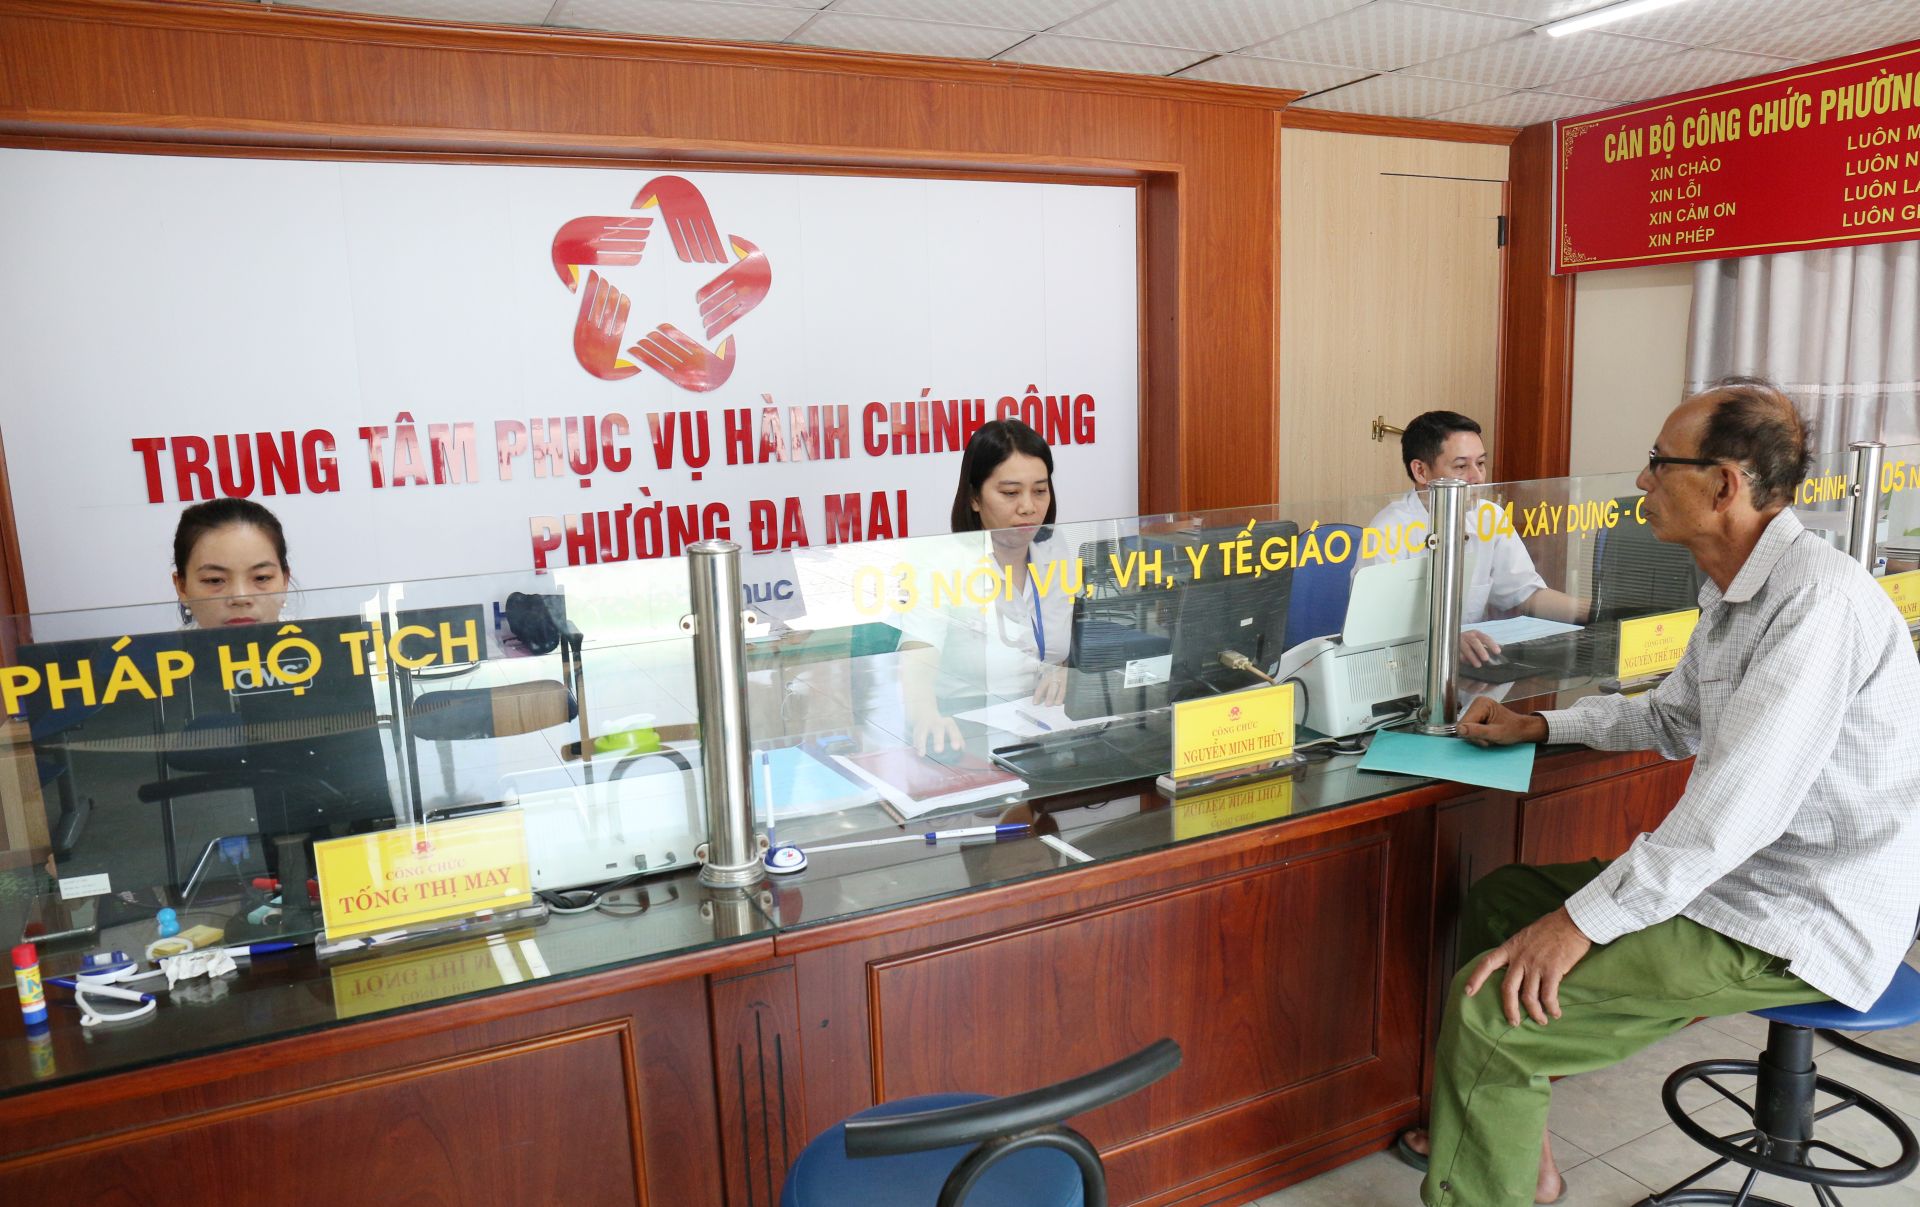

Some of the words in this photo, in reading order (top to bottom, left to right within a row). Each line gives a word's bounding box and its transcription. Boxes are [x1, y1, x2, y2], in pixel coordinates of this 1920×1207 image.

[1604, 125, 1643, 163] CÁN
[1649, 115, 1676, 160] BỘ
[1682, 108, 1741, 149] CÔNG
[1748, 87, 1812, 137] CHỨC
[1847, 126, 1900, 151] LUÔN
[1650, 166, 1674, 181] XIN
[1677, 155, 1721, 178] CHÀO
[1845, 153, 1899, 176] LUÔN
[1650, 188, 1673, 204] XIN
[1677, 178, 1701, 201] LỖI
[1844, 179, 1897, 202] LUÔN
[1649, 210, 1672, 226] XIN
[1676, 202, 1709, 223] CẢM
[1713, 202, 1736, 218] ƠN
[1842, 205, 1895, 227] LUÔN
[1648, 233, 1672, 248] XIN
[1676, 226, 1715, 245] PHÉP
[131, 428, 341, 504] TRUNG
[358, 411, 479, 488] TÂM
[494, 412, 632, 488] PHỤC
[646, 410, 711, 481] VỤ
[724, 393, 851, 466] HÀNH
[862, 388, 986, 457] CHÍNH
[1802, 468, 1847, 505] CHÍNH
[1880, 461, 1906, 493] 05
[529, 486, 731, 575] PHƯỜNG
[748, 497, 809, 555] ĐA
[824, 490, 909, 544] MAI
[1477, 501, 1514, 542] 04
[1522, 501, 1563, 538] XÂY
[1567, 499, 1619, 539] DỰNG
[852, 562, 920, 615] 03
[931, 556, 1013, 615] NỘI
[1028, 558, 1094, 605] VỤ,
[1110, 550, 1174, 589] VH,
[1185, 544, 1209, 580] Y
[1362, 521, 1426, 565] DỤC
[0, 635, 195, 715] PHÁP
[218, 624, 322, 696] HỘ
[1184, 738, 1228, 765] NGUYỄN
[1228, 738, 1255, 757] MINH
[386, 865, 424, 881] CÔNG
[339, 885, 409, 915] TỐNG
[415, 877, 458, 898] THỊ
[464, 867, 512, 891] MAY
